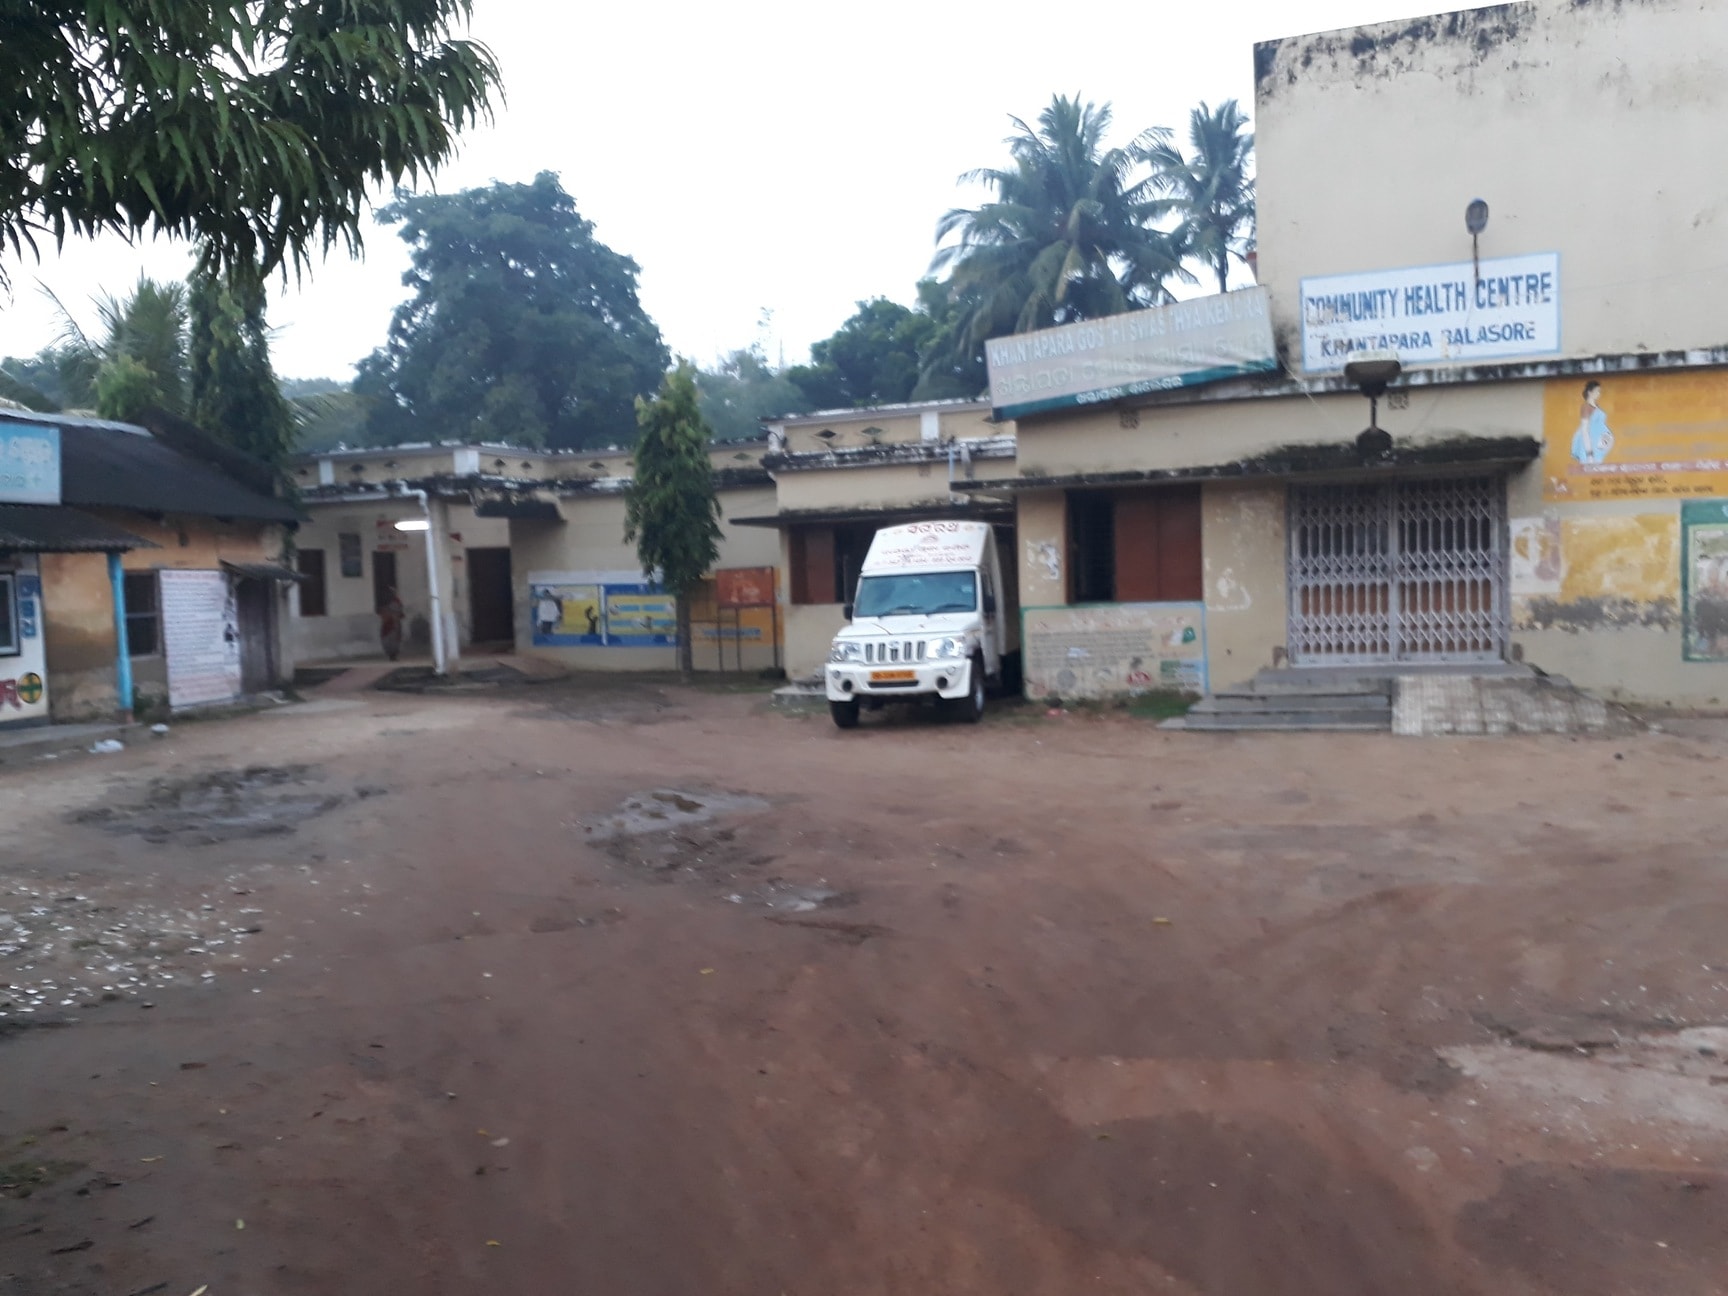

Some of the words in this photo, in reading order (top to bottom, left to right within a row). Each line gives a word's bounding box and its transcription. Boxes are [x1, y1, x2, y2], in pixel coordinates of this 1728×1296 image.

[1306, 287, 1399, 325] COMMUNITY
[1404, 281, 1466, 317] HEALTH
[1475, 271, 1552, 309] CENTRE
[1321, 331, 1433, 357] KHANTAPARA
